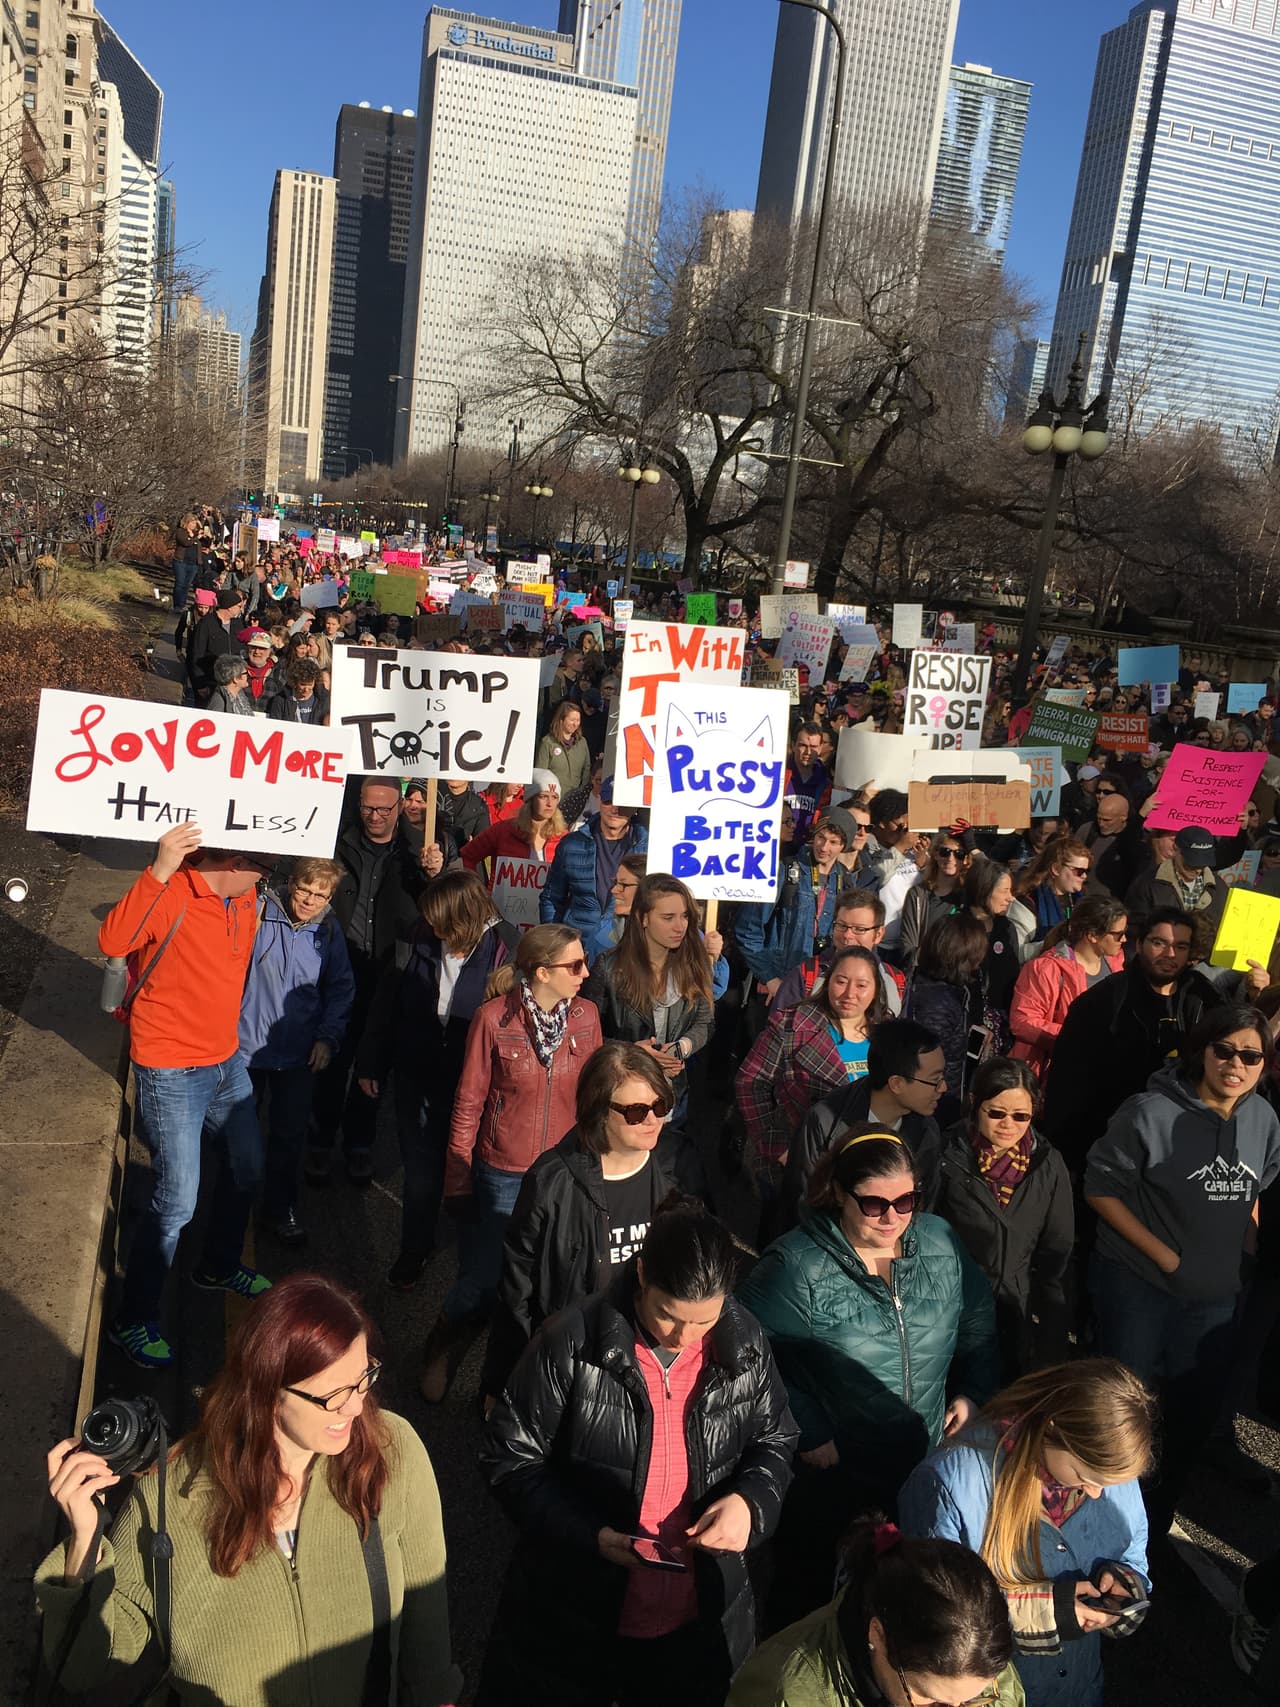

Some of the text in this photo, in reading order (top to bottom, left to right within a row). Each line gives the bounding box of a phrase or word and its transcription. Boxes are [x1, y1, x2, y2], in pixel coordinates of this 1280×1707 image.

[474, 29, 557, 62] Prudential
[665, 625, 743, 672] With
[346, 646, 509, 704] Trump
[911, 653, 990, 695] RESIST
[694, 711, 728, 725] THIS
[1031, 717, 1095, 737] STANDS WITH
[1035, 705, 1098, 729] SIERRA CLUB
[1101, 716, 1146, 733] RESIST
[1028, 725, 1091, 749] IMMIGRANTS
[1126, 734, 1147, 744] HATE
[1202, 756, 1245, 773] RESPECT
[1180, 769, 1245, 788] EXISTENCE
[1184, 795, 1228, 810] EXPECT
[496, 861, 550, 890] MARC
